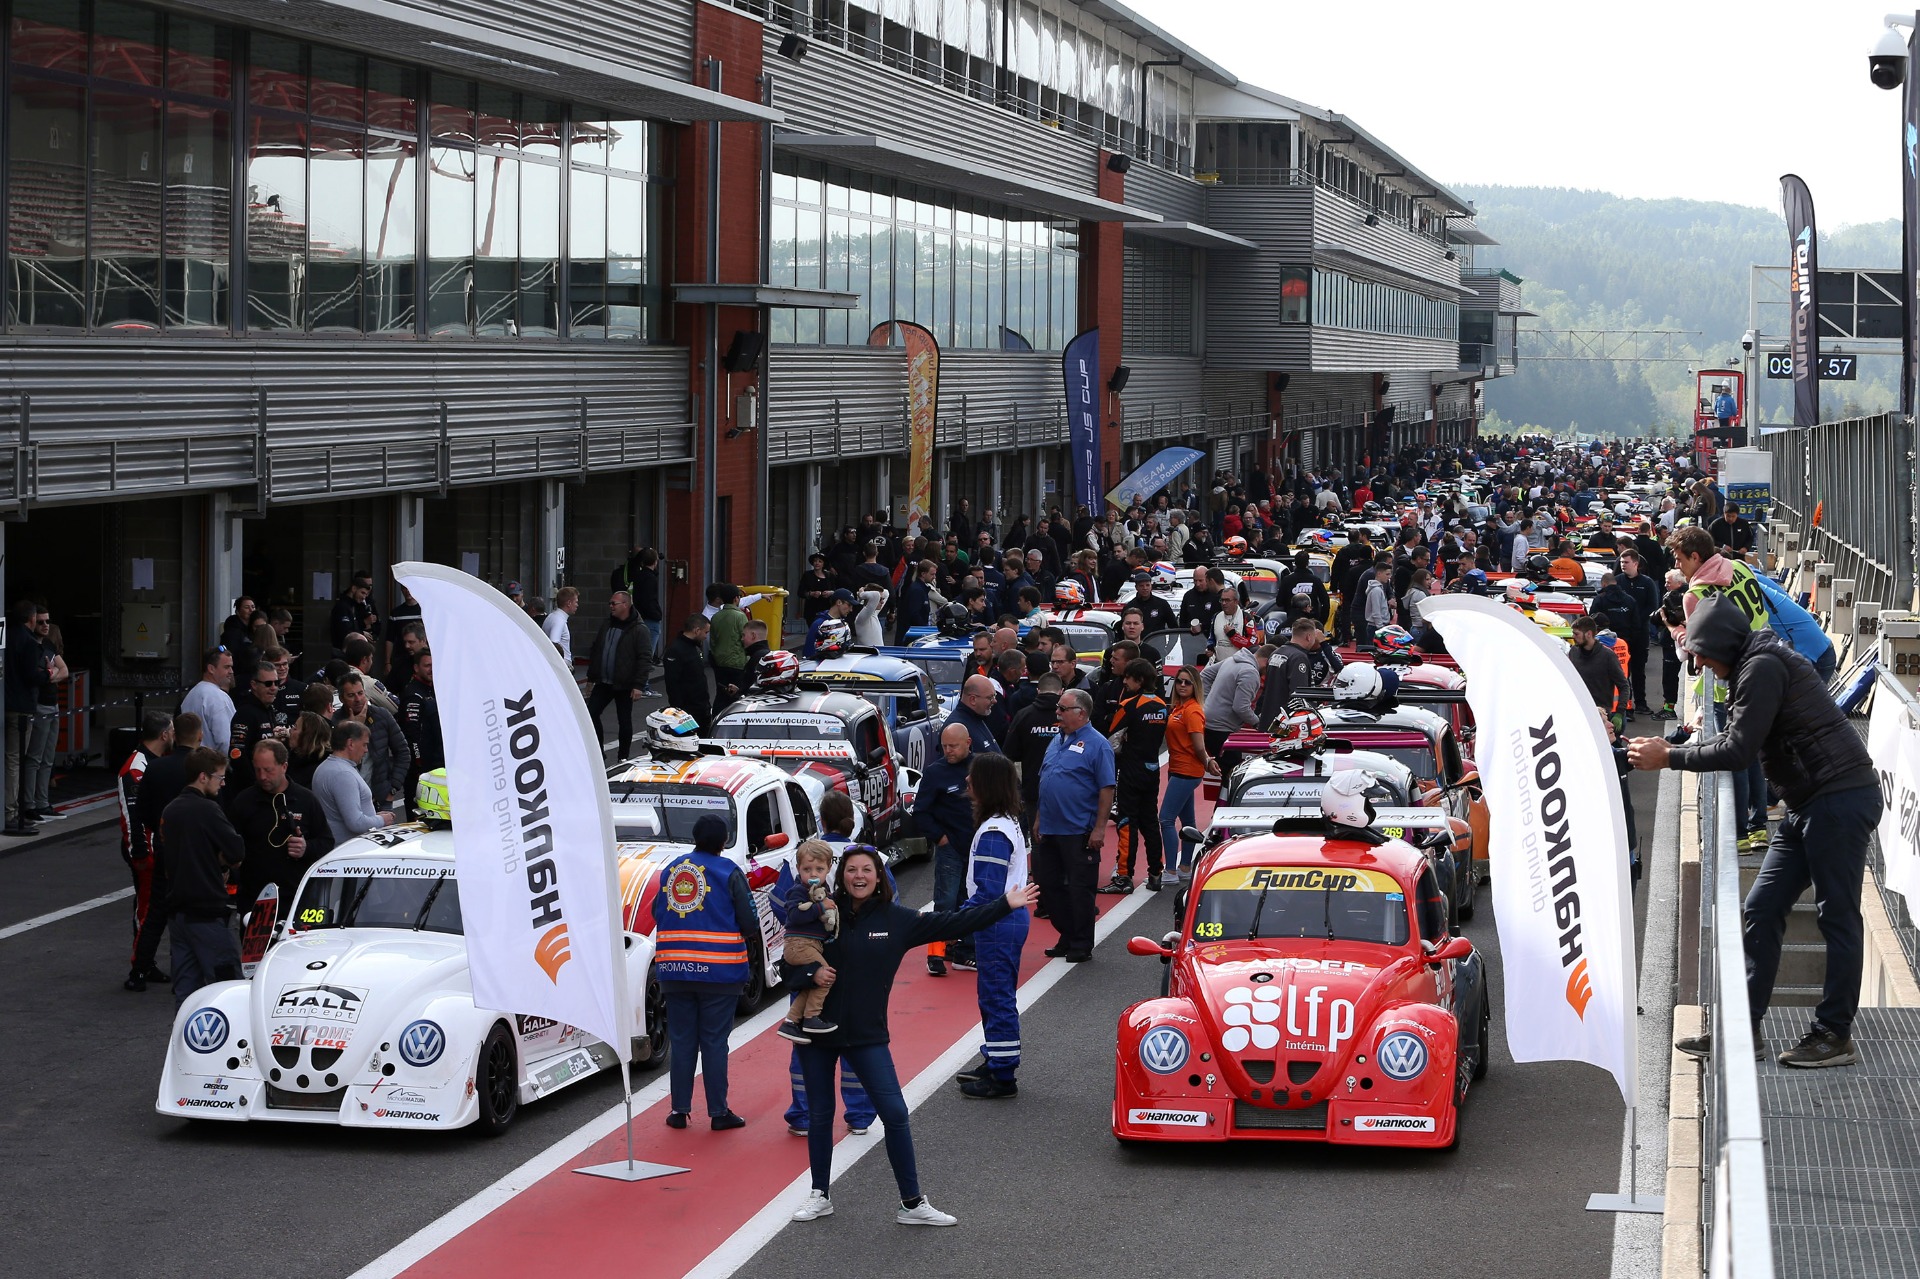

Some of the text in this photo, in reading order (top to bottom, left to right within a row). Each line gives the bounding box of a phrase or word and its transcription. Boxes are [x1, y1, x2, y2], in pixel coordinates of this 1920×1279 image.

[1079, 359, 1091, 405] CUP
[1136, 462, 1166, 489] TEAM
[1142, 480, 1160, 495] Pole
[1160, 455, 1191, 482] Position
[741, 716, 821, 725] www.vwfuncup.eu
[910, 741, 924, 771] 161
[863, 774, 884, 807] 499
[1382, 827, 1403, 839] 269
[342, 864, 456, 878] www.vwfuncup.eu
[1251, 869, 1358, 892] FunCup
[300, 908, 325, 923] 426
[1196, 922, 1223, 938] 433
[659, 962, 709, 973] PROMAS.be
[278, 996, 357, 1012] HALL
[275, 1007, 354, 1019] concept
[1287, 984, 1355, 1053] lfp
[1285, 1040, 1326, 1052] Intérim
